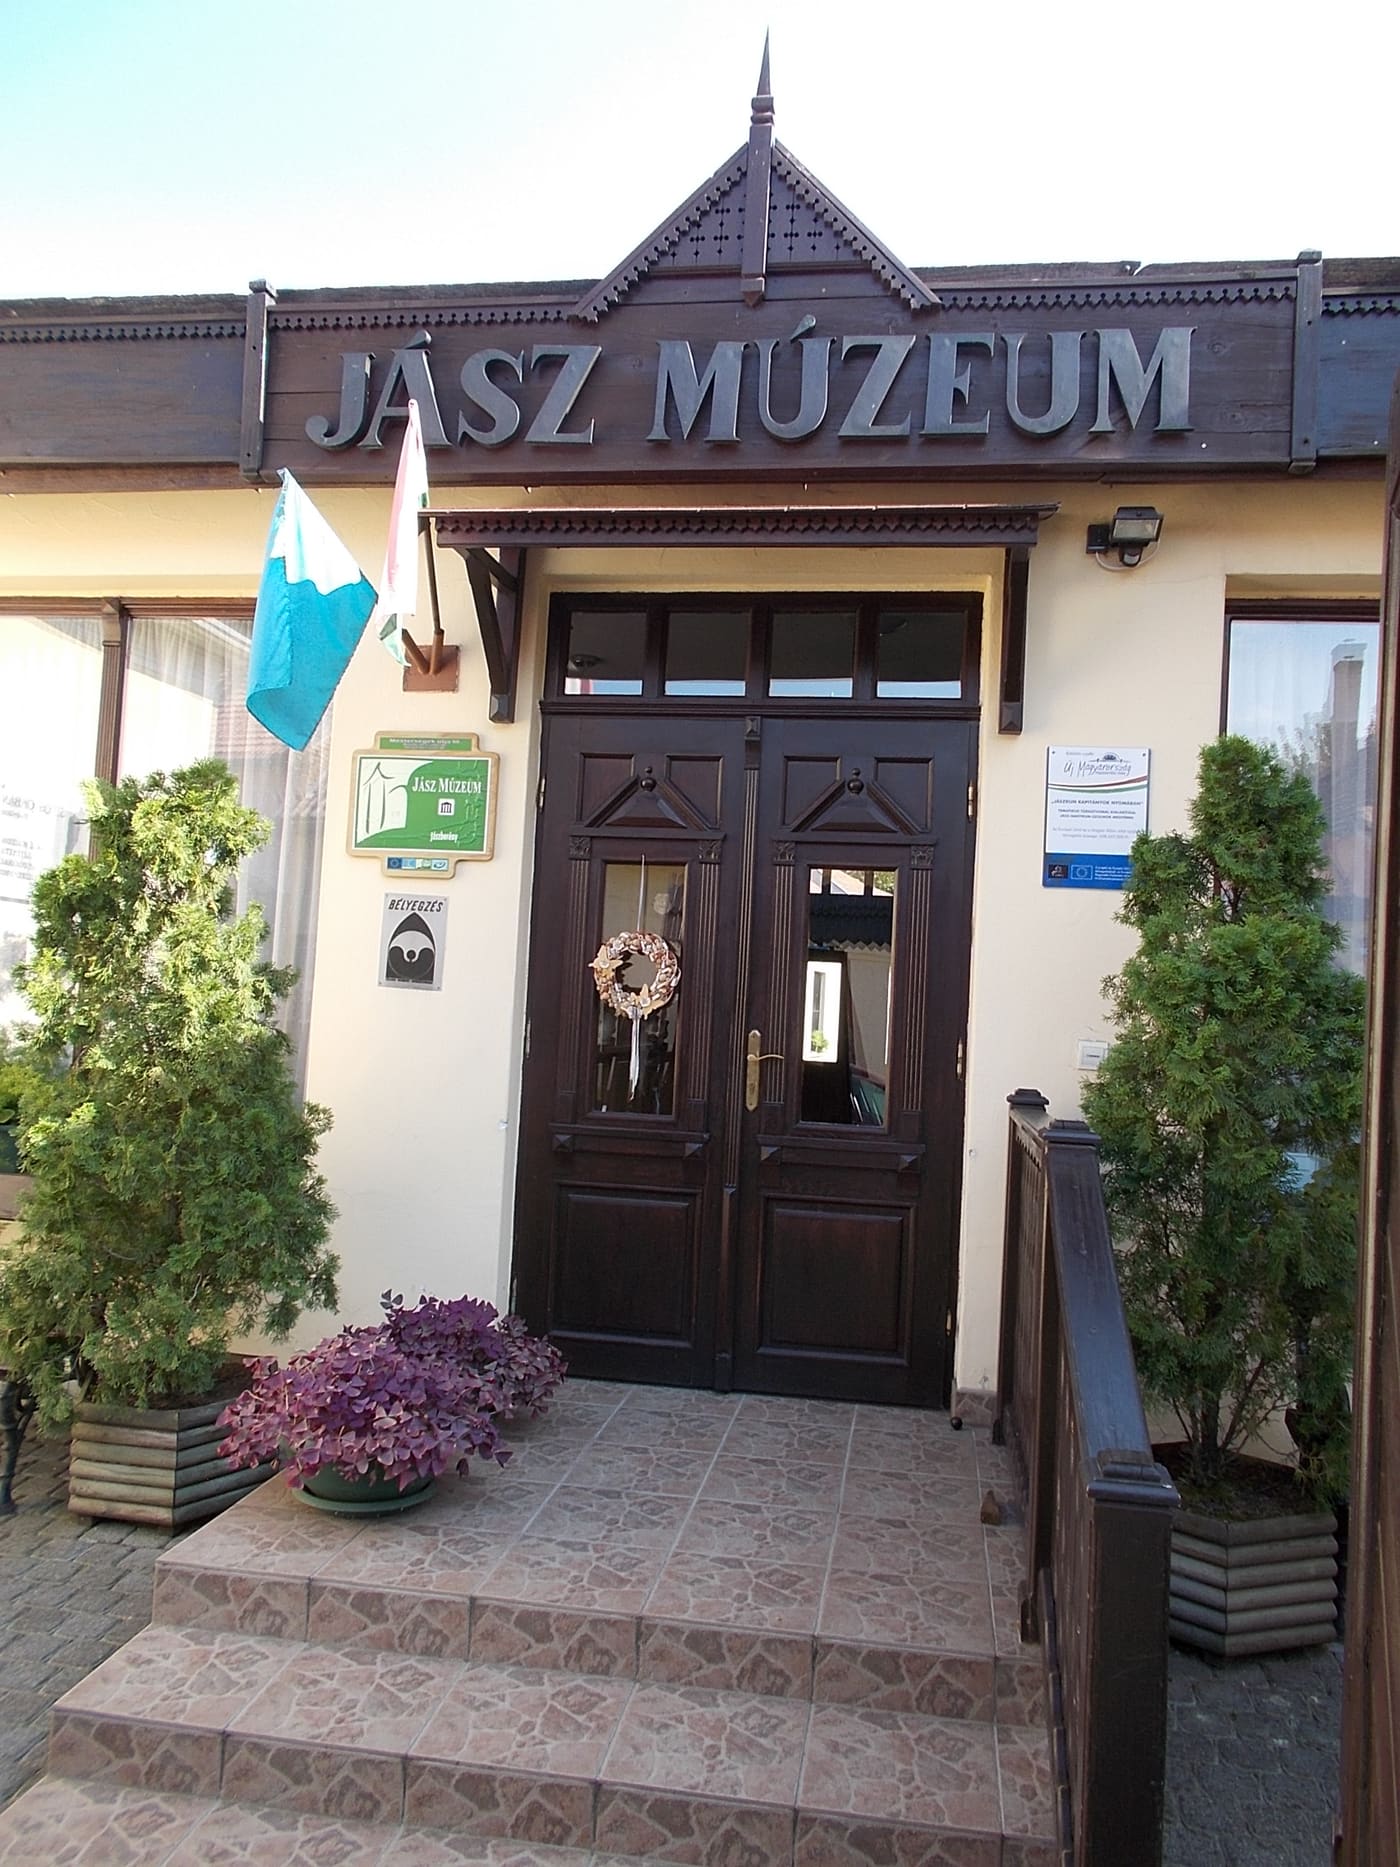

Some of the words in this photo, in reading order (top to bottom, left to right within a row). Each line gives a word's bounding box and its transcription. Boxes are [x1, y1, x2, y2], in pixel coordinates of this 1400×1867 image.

[305, 330, 601, 450] JÁSZ
[645, 315, 1197, 444] MÚZEUM
[412, 777, 437, 793] JÁSZ
[438, 777, 482, 794] MÚZEUM
[388, 898, 444, 913] BÉLYEGZÉS
